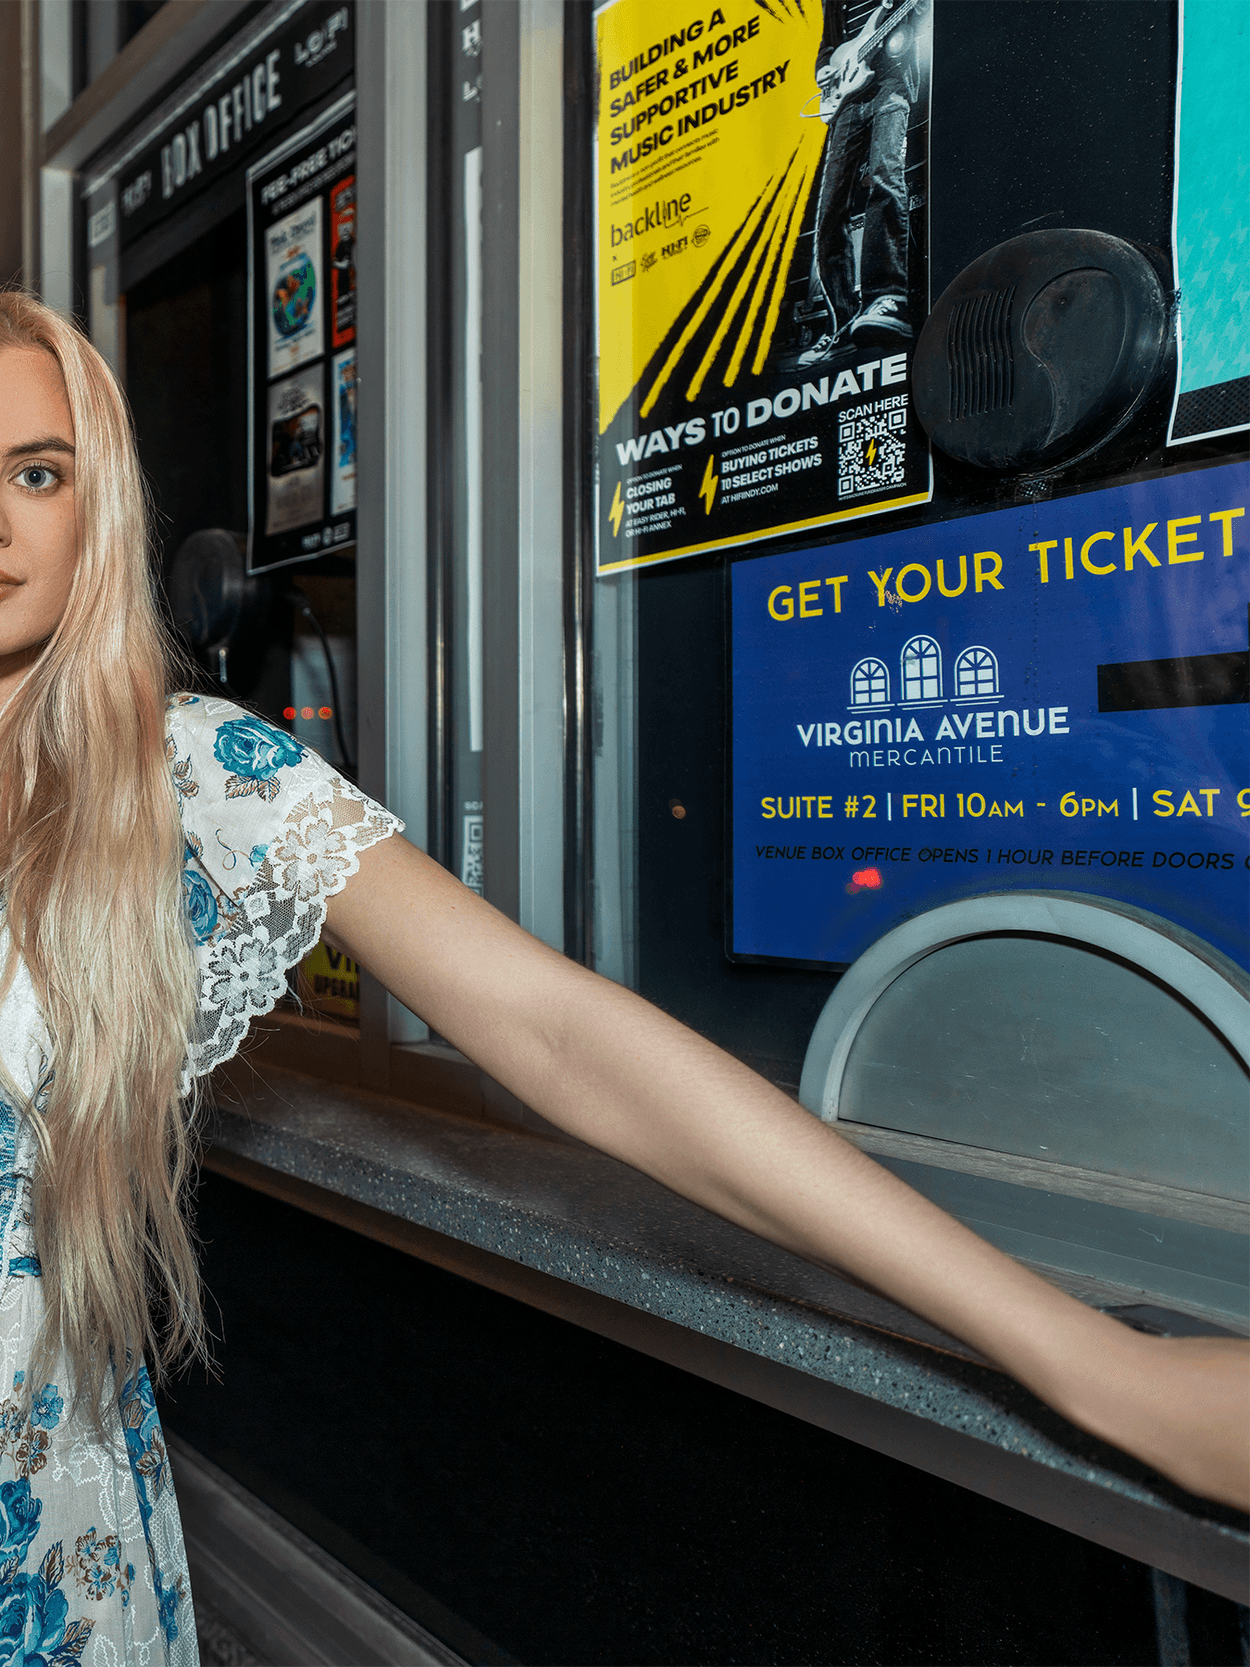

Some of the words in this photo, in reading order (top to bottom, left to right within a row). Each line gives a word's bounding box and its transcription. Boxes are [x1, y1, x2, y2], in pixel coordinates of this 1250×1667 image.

[610, 20, 704, 90] BUILDING
[708, 8, 726, 32] A
[610, 68, 669, 118] SAFER
[673, 58, 689, 80] &
[693, 15, 760, 69] MORE
[610, 59, 739, 146] SUPPORTIVE
[610, 125, 674, 174] MUSIC
[677, 59, 791, 136] INDUSTRY
[161, 120, 203, 199] BOX
[203, 48, 282, 161] OFFICE
[611, 193, 691, 247] backline
[616, 418, 706, 466] WAYS
[712, 407, 741, 438] TO
[747, 353, 907, 428] DONATE
[838, 403, 872, 423] SCAN
[875, 394, 909, 413] HERE
[721, 451, 767, 474] BUYING
[768, 436, 819, 460] TICKETS
[721, 478, 732, 491] TO
[732, 466, 774, 488] SELECT
[774, 453, 823, 477] SHOWS
[626, 477, 672, 499] CLOSING
[626, 498, 654, 515] YOUR
[654, 492, 676, 508] TAB
[768, 575, 848, 621] GET
[867, 551, 1005, 607] YOUR
[1029, 507, 1245, 583] TICKET
[797, 717, 924, 747] VIRGINIA
[935, 706, 1070, 741] AVENUE
[850, 744, 1003, 768] MERCANTILE
[761, 795, 833, 818] SUITE
[845, 795, 877, 818] #2
[903, 794, 945, 817] FRI
[957, 793, 1024, 818] 10AM
[1060, 791, 1119, 817] 6PM
[1152, 789, 1221, 817] SAT
[756, 846, 807, 860] VENUE
[811, 846, 846, 860] BOX
[851, 847, 912, 861] OFFICE
[918, 848, 979, 863] OPENS
[986, 849, 992, 863] 1
[997, 849, 1054, 865] HOUR
[1061, 851, 1145, 867] BEFORE
[1152, 852, 1235, 870] DOORS
